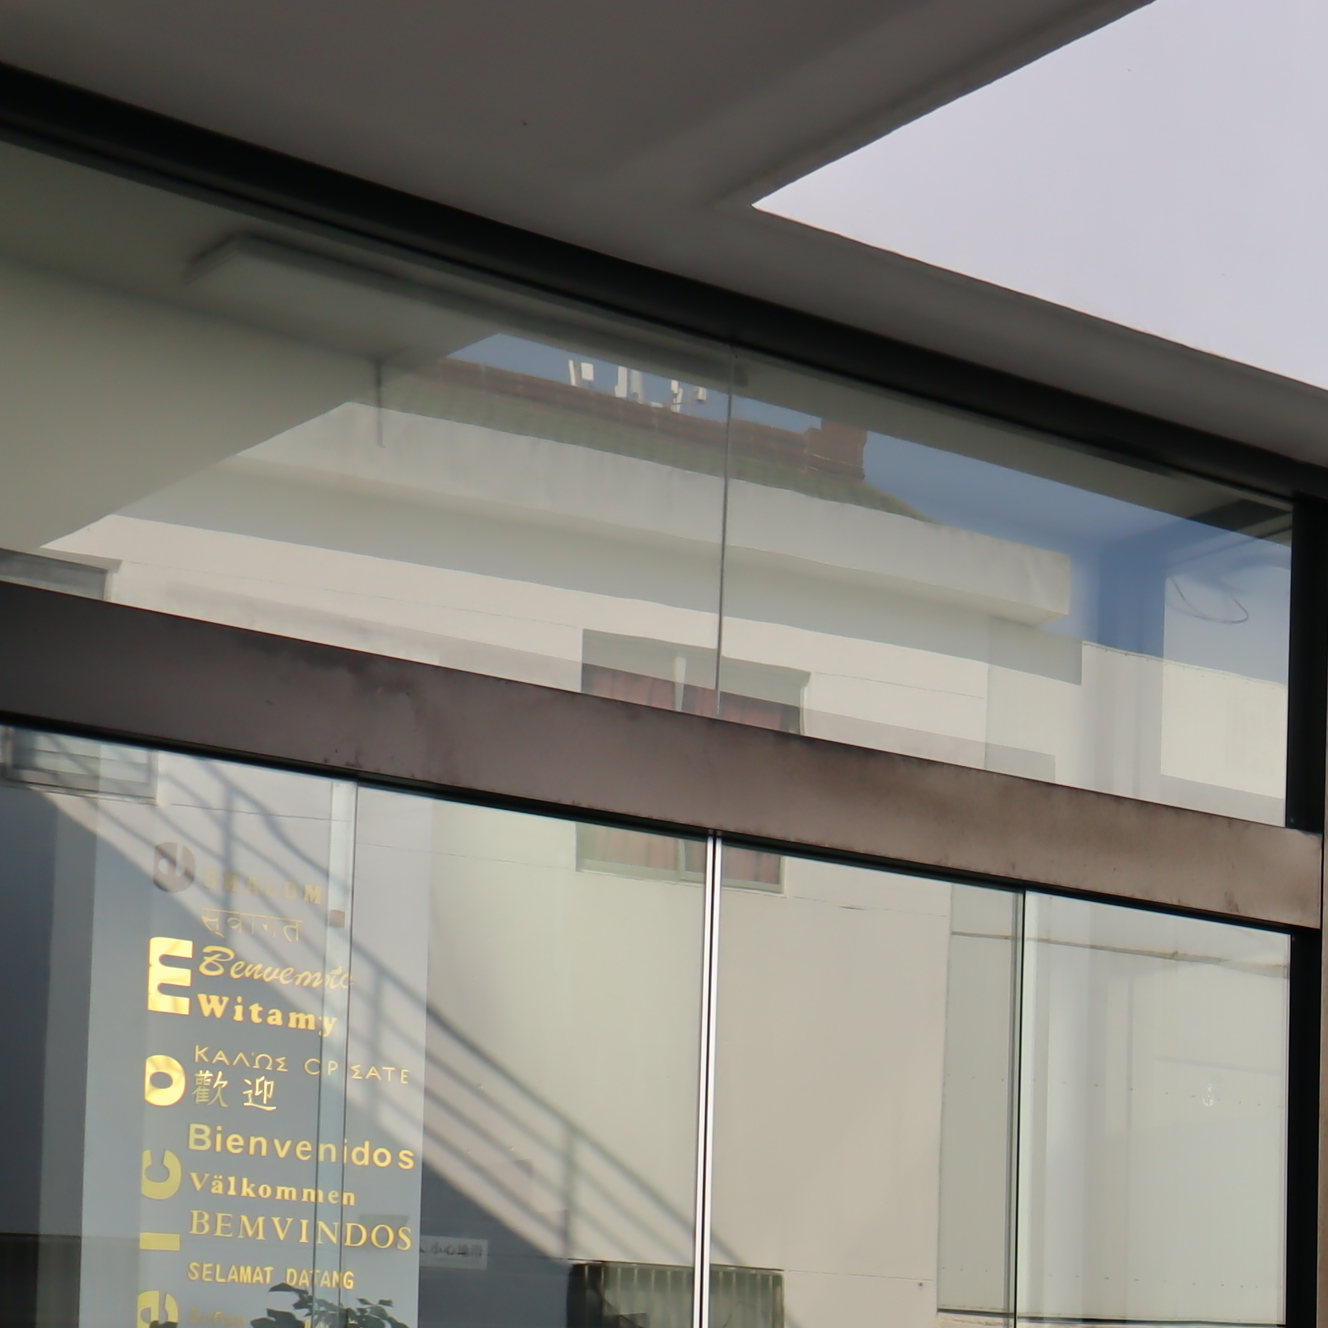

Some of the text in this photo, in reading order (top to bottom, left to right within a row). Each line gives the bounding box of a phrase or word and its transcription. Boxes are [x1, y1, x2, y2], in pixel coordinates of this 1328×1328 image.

[197, 993, 338, 1037] Witamy
[191, 1070, 276, 1110] 歡迎
[188, 1123, 415, 1171] Bienvenidos
[189, 1172, 357, 1206] Välkommen
[189, 1209, 413, 1252] BEMVINDOS
[187, 1262, 355, 1290] SELAMAT DATANG
